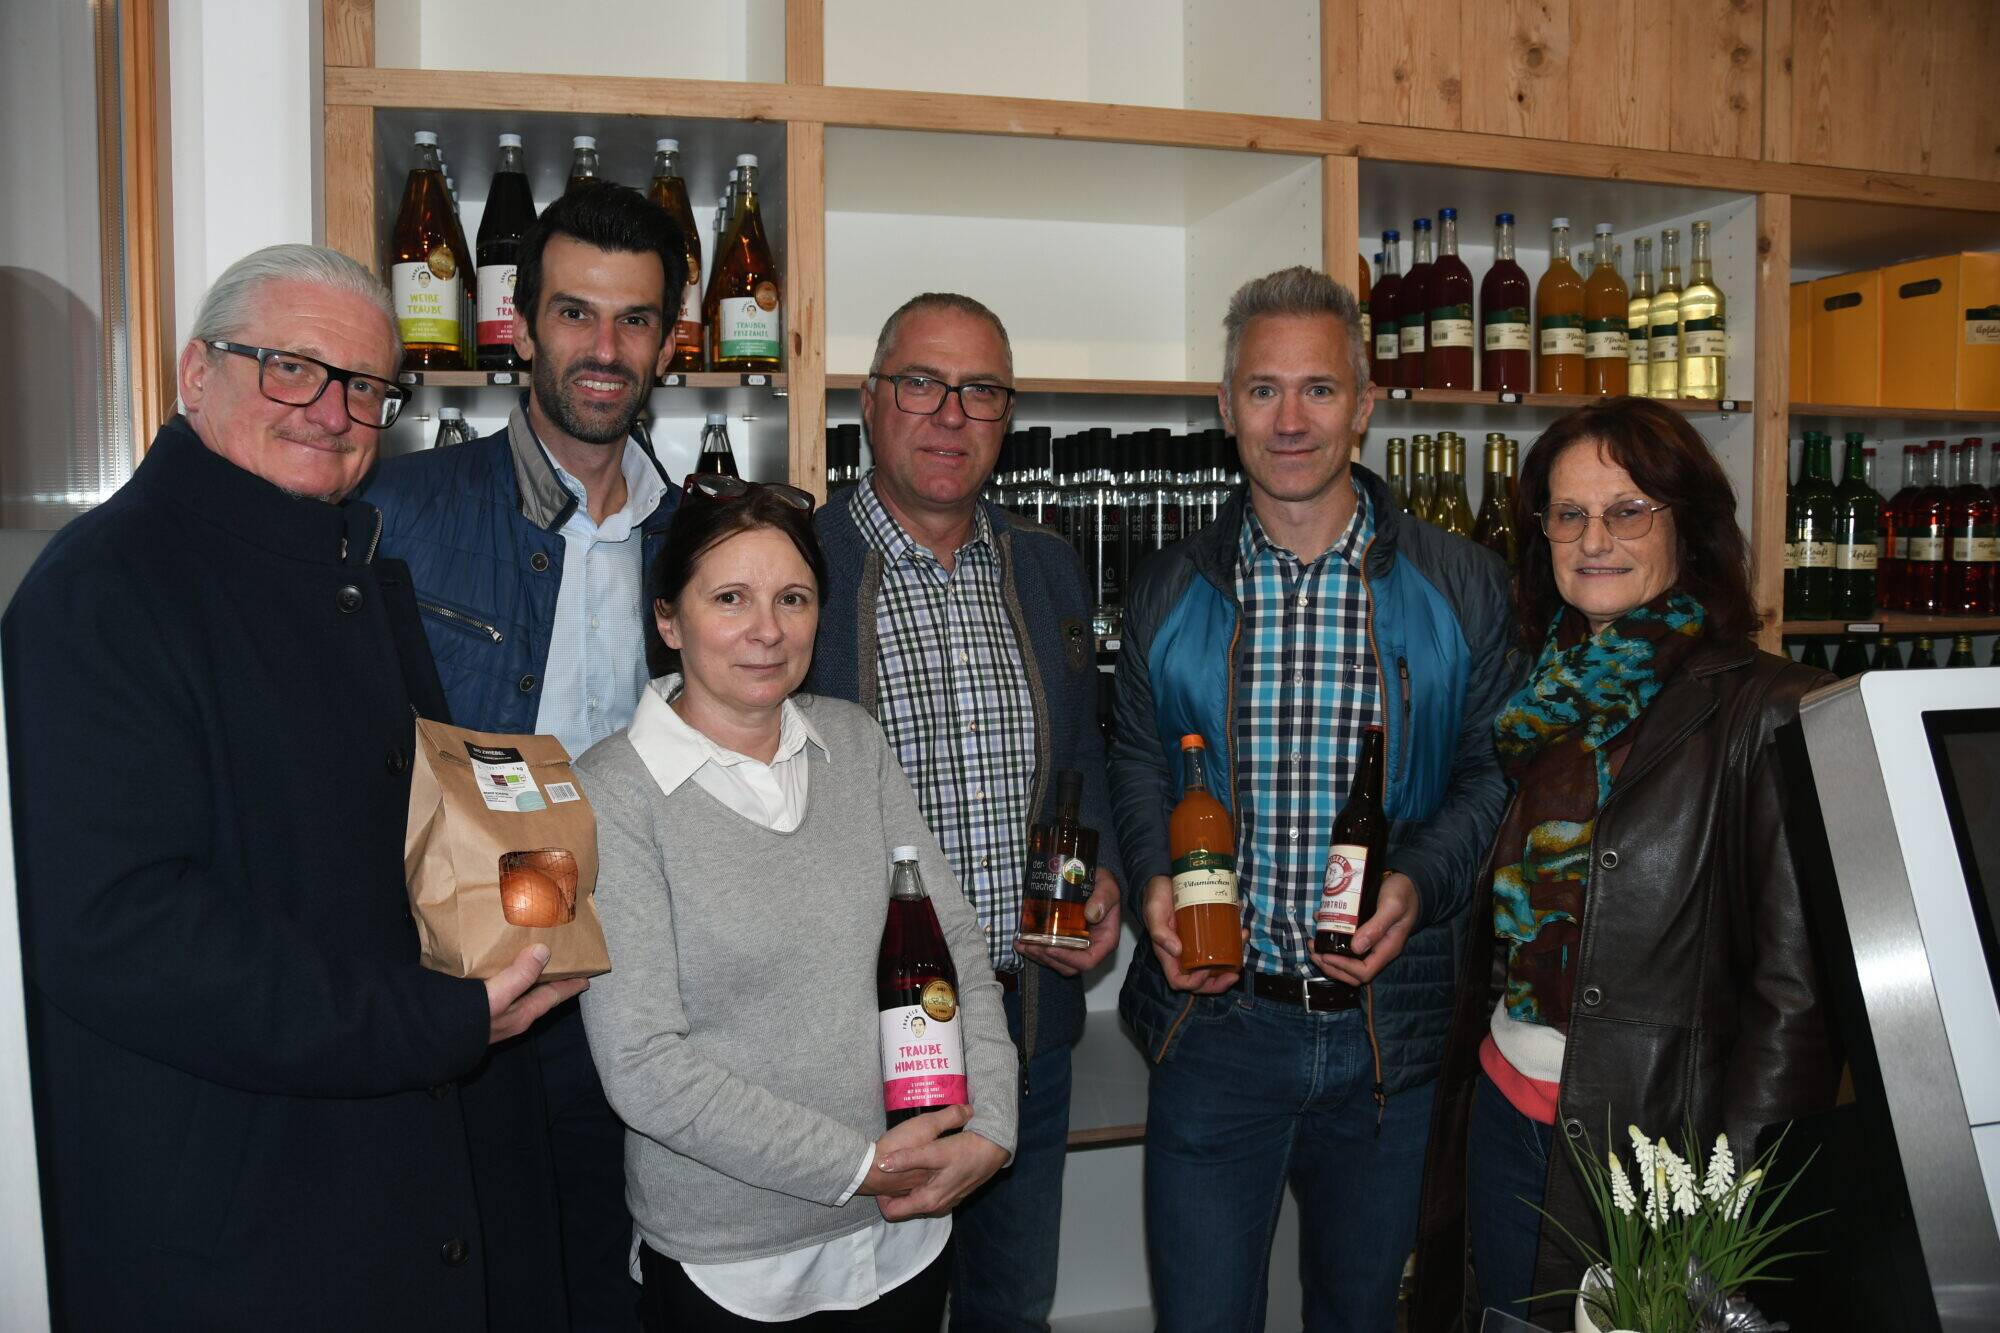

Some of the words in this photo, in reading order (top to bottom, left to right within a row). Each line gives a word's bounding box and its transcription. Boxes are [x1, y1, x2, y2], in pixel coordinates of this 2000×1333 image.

[502, 295, 514, 305] RO
[407, 305, 443, 315] TRAUBE
[496, 307, 513, 317] TRA
[482, 748, 506, 756] ZWIEBEL
[1183, 878, 1230, 889] Vitaminchen
[899, 1044, 943, 1058] TRAUBE
[895, 1057, 950, 1074] HIMBEERE
